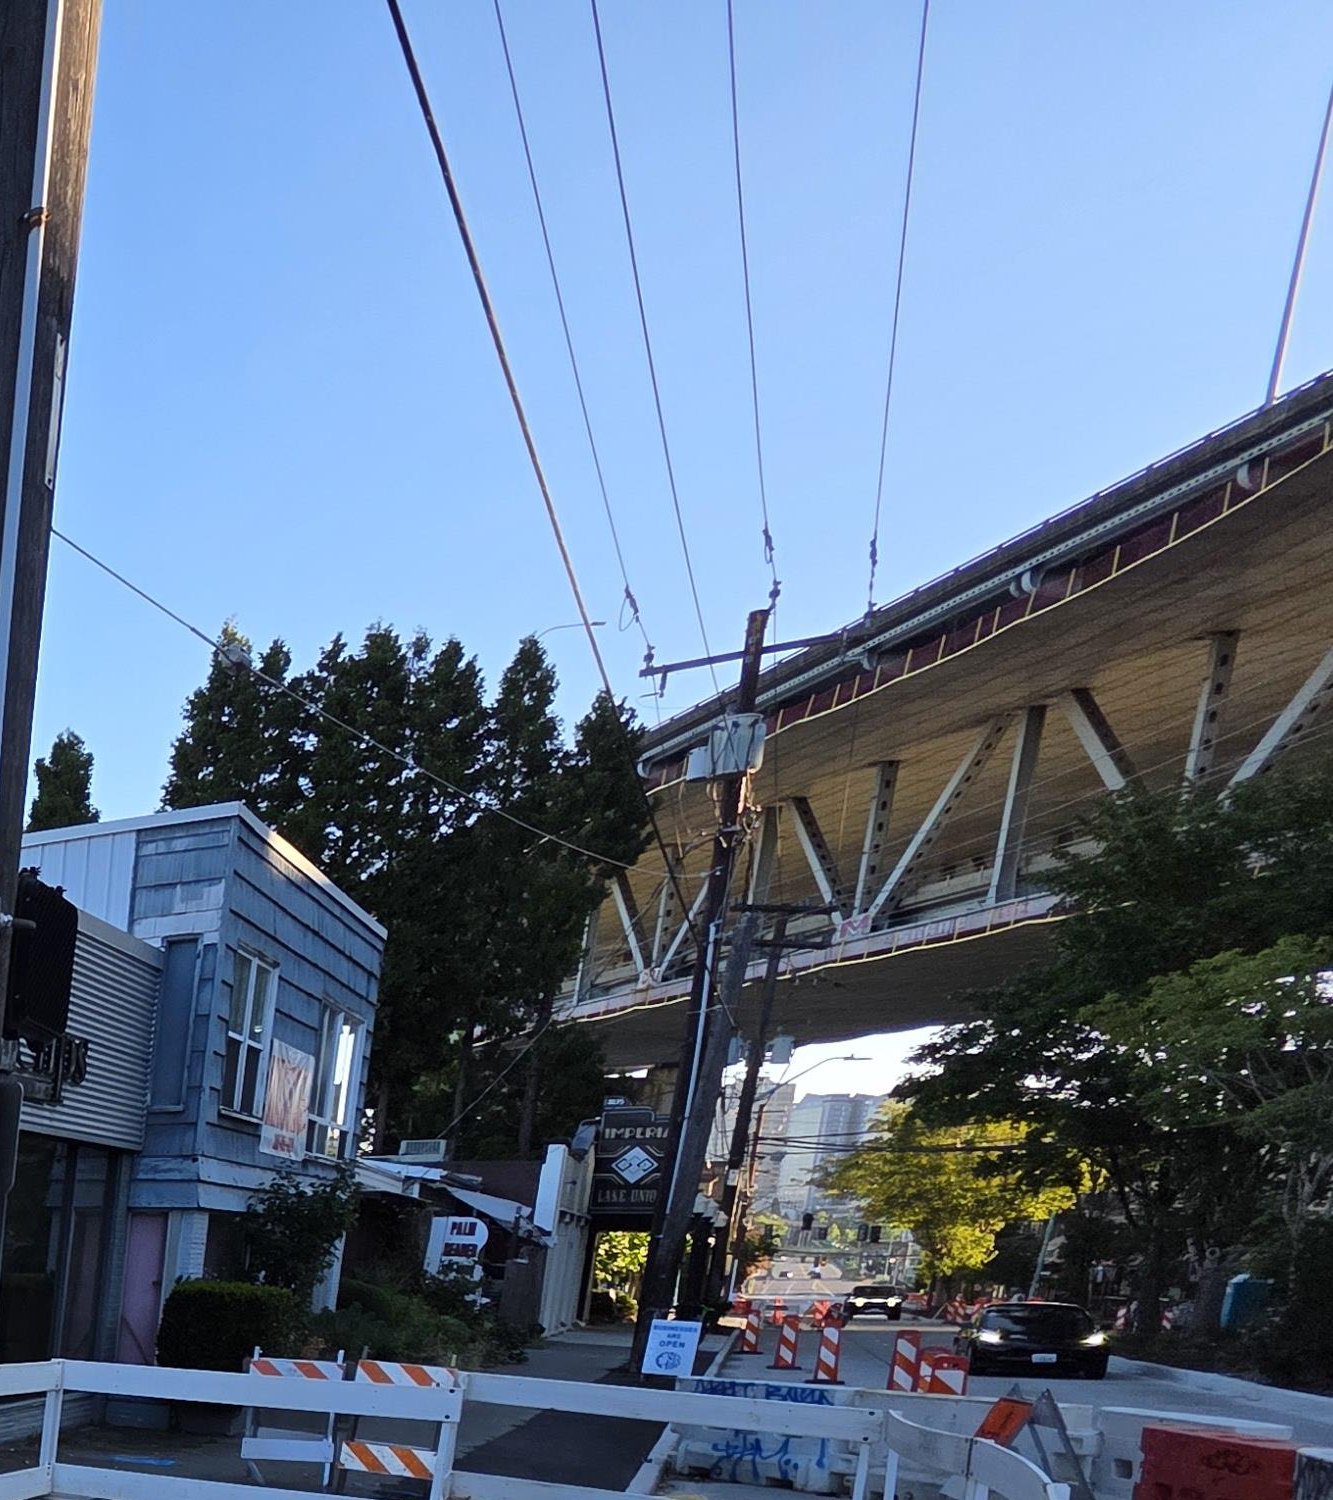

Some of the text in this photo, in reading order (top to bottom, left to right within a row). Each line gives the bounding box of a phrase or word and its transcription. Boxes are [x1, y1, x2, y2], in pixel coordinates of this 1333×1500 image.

[604, 1126, 669, 1139] IMPERI
[630, 1189, 658, 1204] UNIO
[659, 1340, 685, 1348] OPEN
